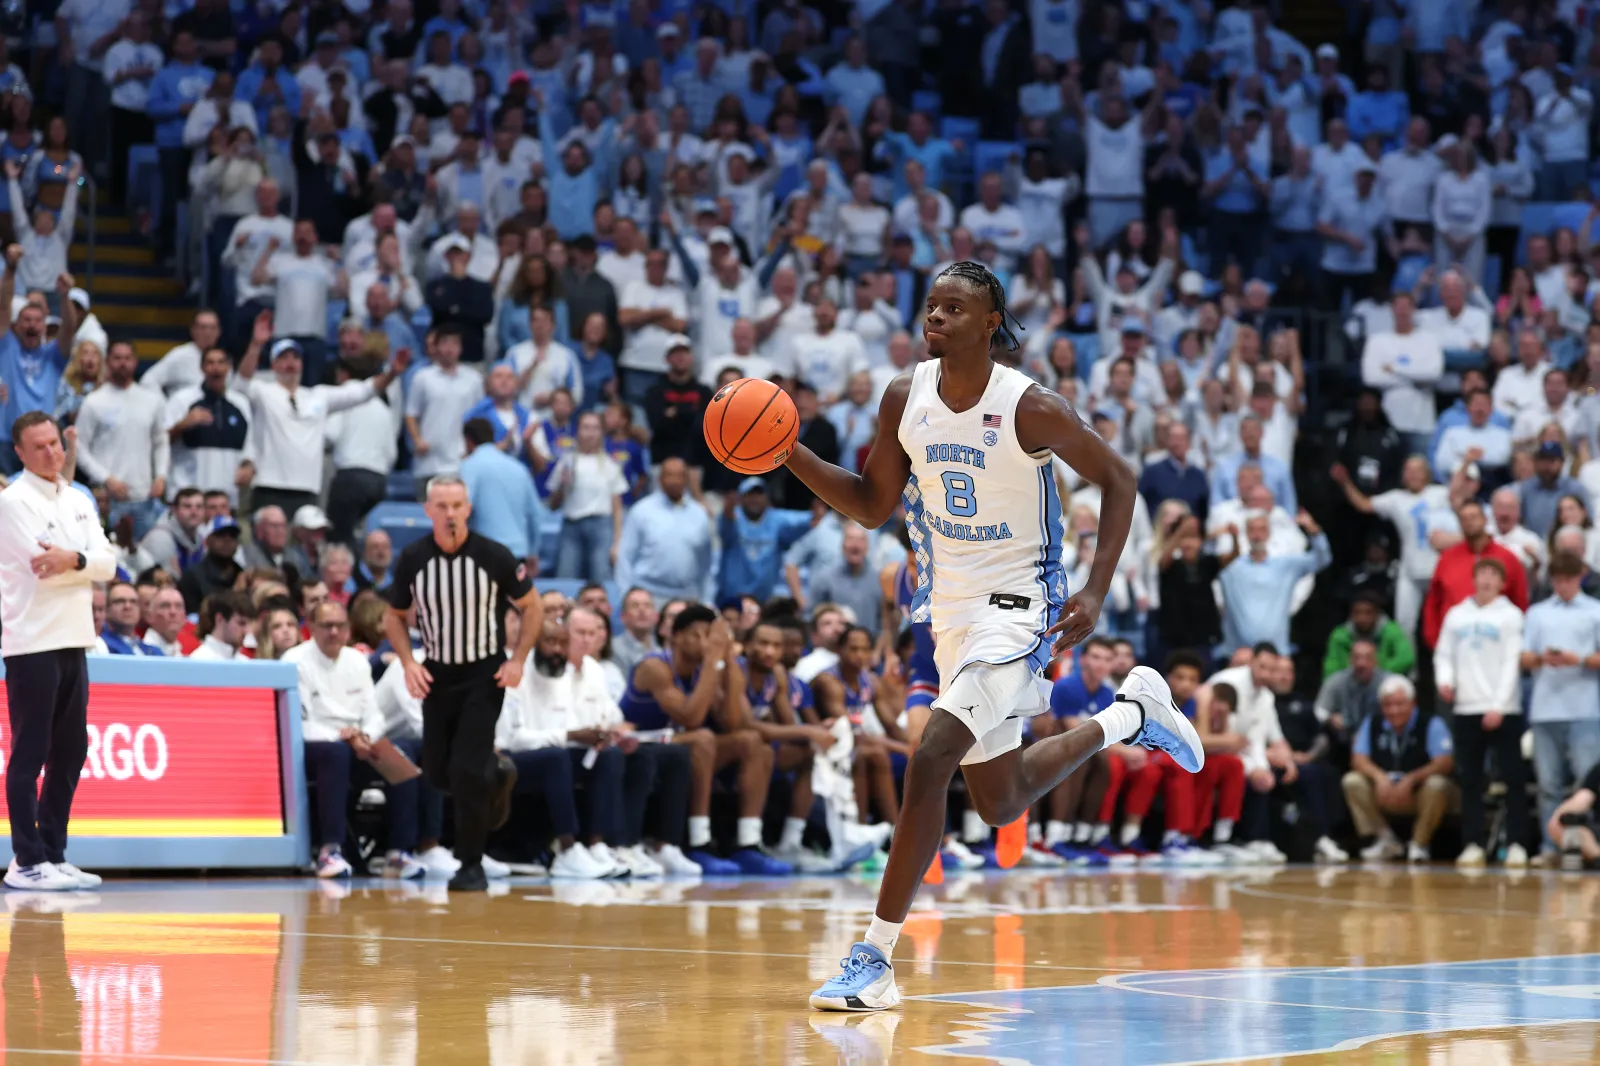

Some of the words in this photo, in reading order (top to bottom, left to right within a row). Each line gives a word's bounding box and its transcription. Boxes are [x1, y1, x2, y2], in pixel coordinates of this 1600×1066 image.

[926, 444, 985, 469] NORTH
[941, 471, 977, 517] 8
[920, 510, 1012, 541] CAROLINA
[40, 723, 168, 780] RGO
